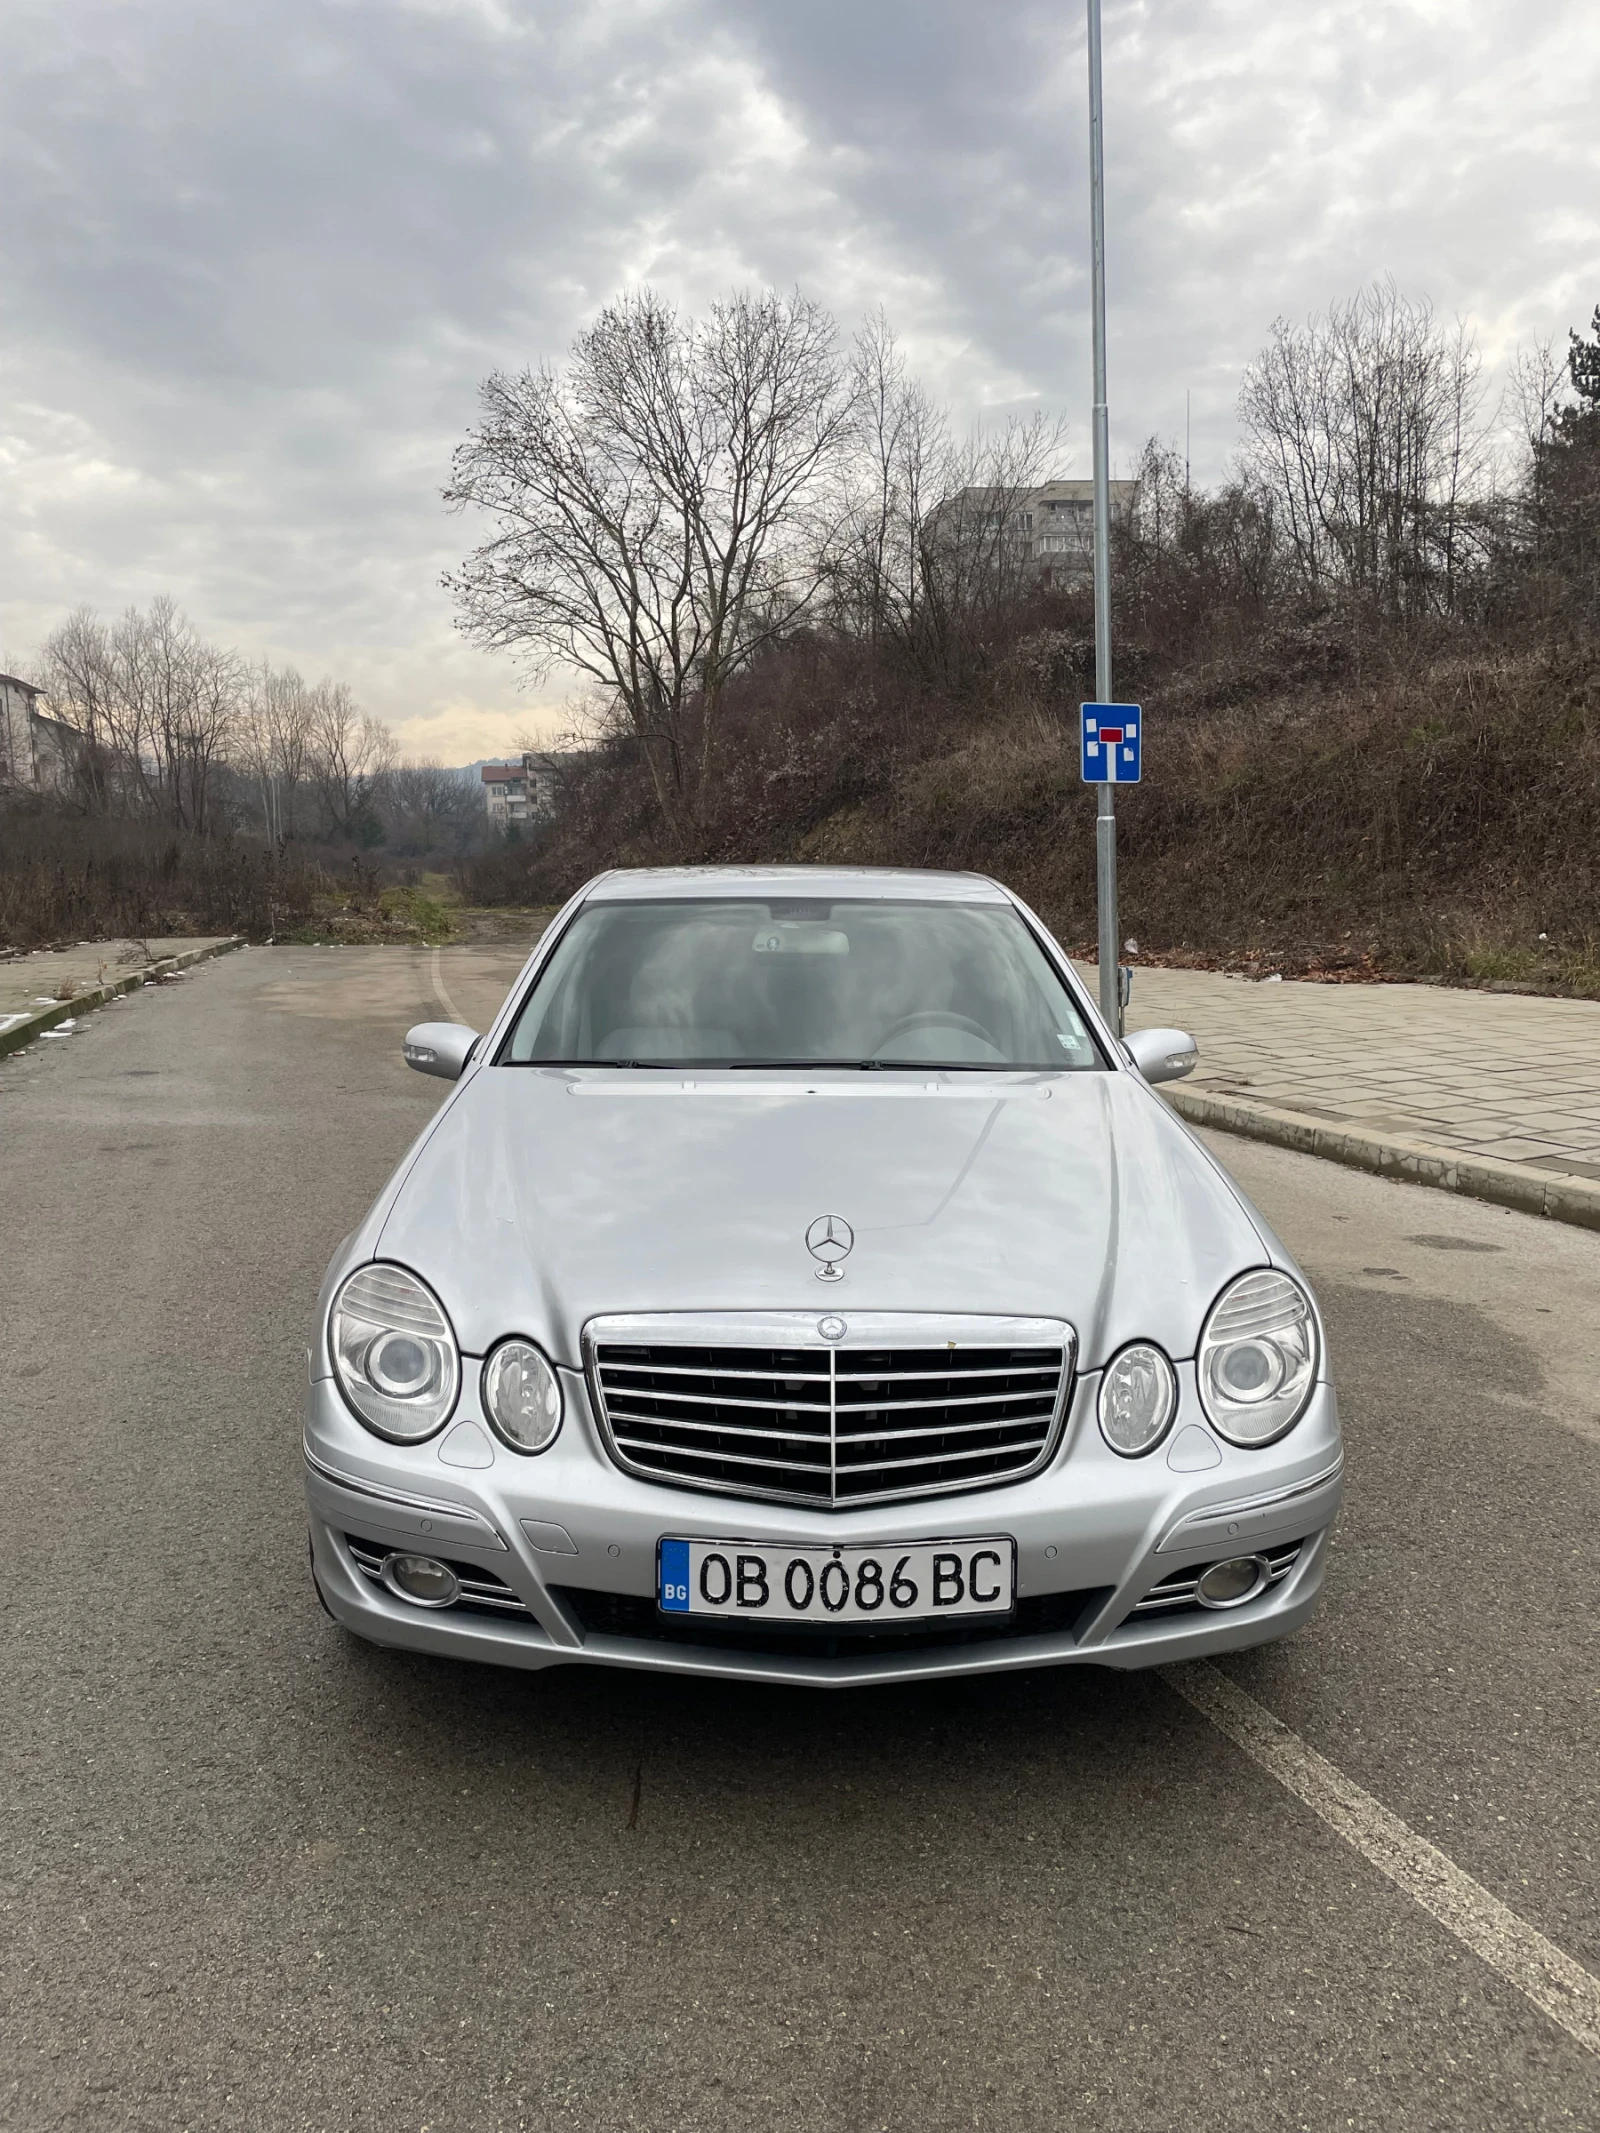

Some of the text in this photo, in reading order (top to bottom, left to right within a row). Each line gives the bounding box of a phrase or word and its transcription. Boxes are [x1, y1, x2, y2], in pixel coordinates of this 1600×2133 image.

[664, 1583, 687, 1601] BG
[699, 1550, 1001, 1612] OB 0086 BC
